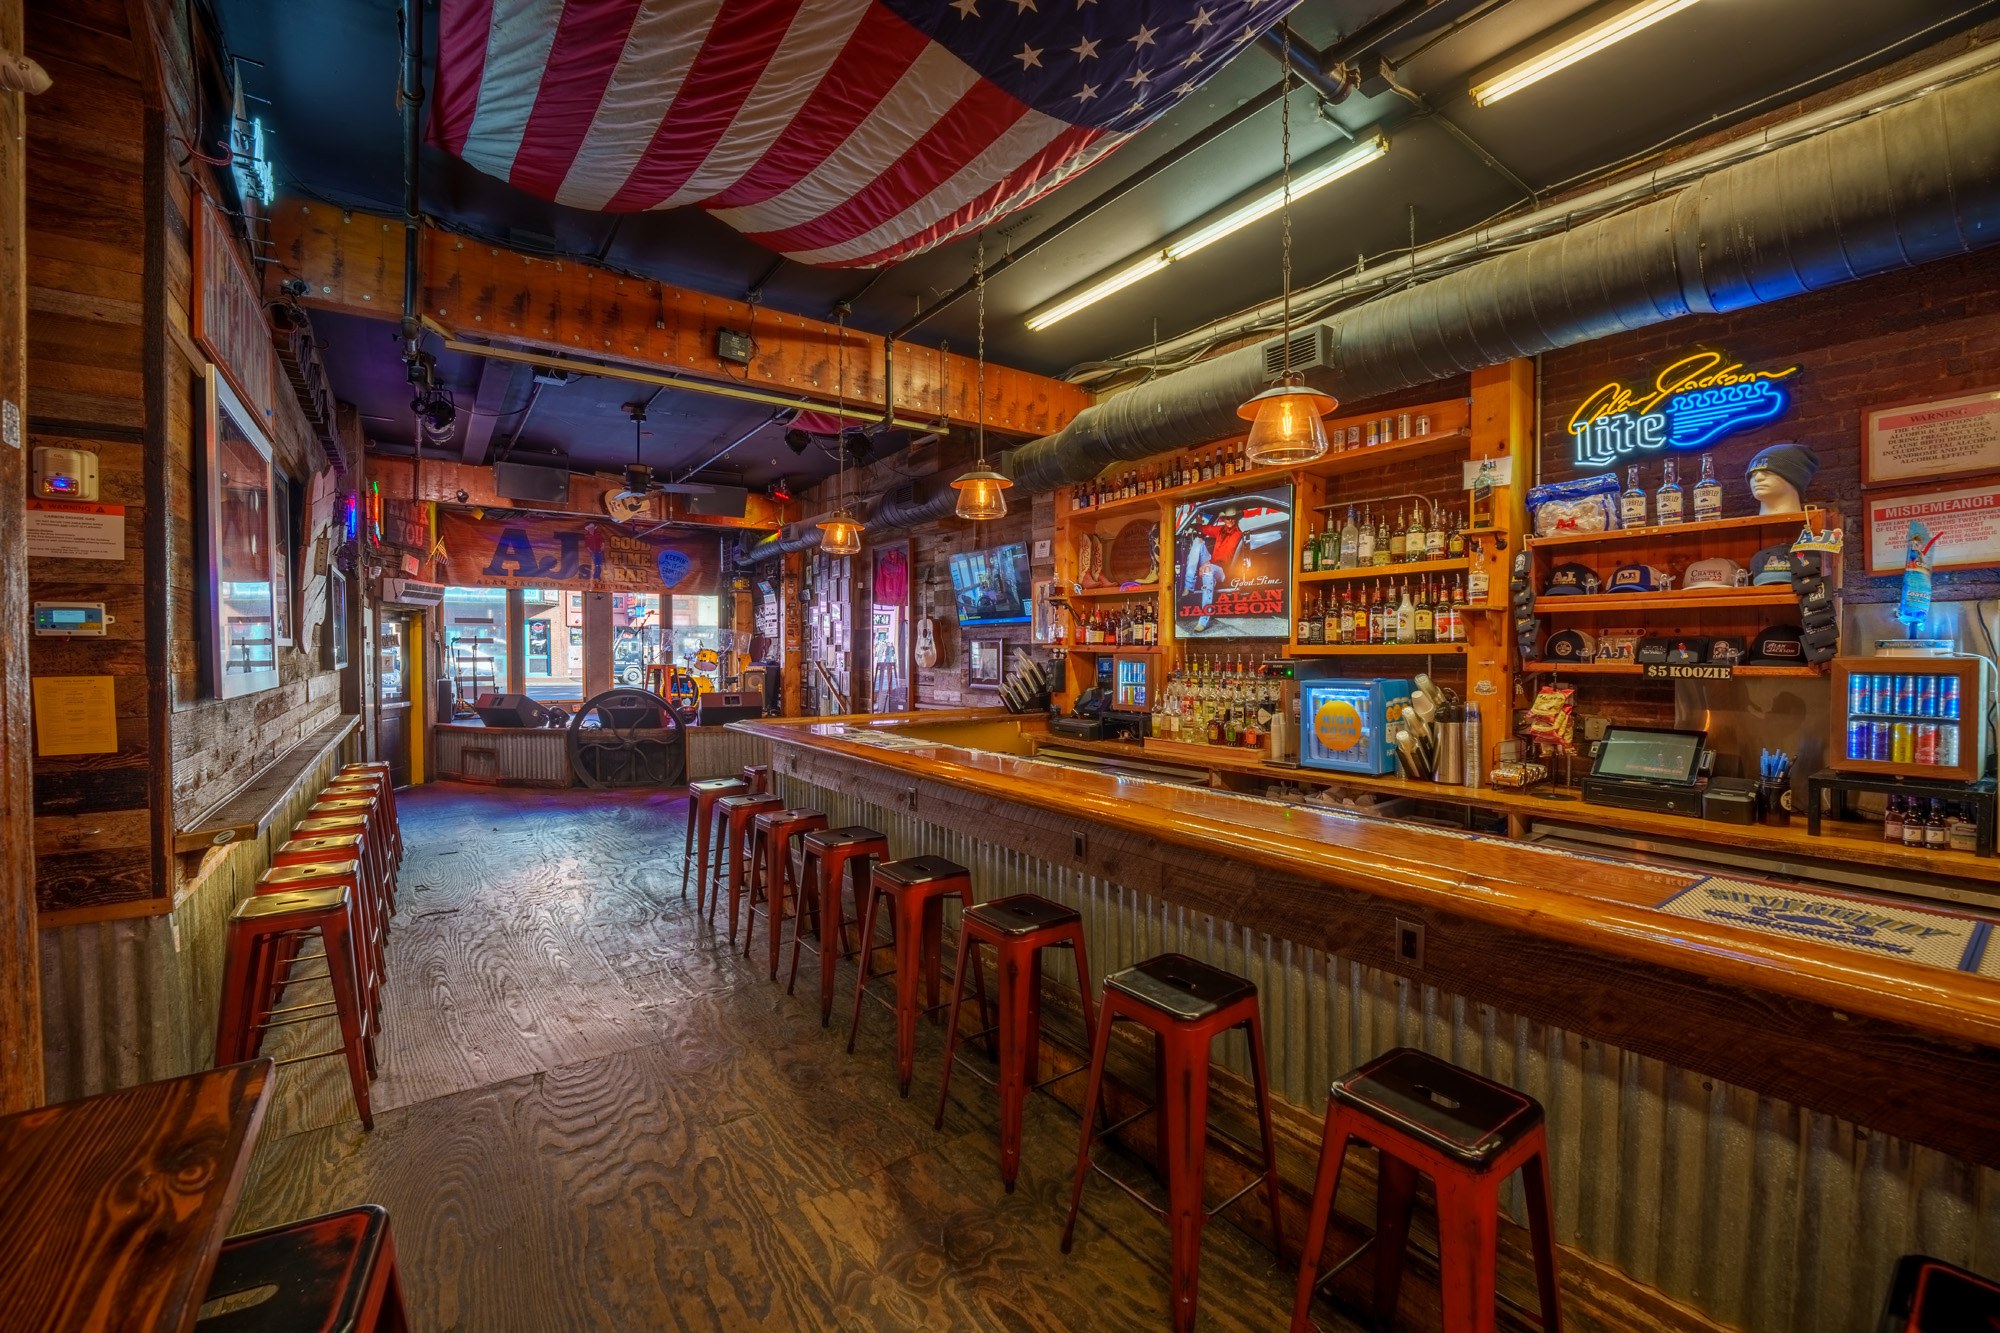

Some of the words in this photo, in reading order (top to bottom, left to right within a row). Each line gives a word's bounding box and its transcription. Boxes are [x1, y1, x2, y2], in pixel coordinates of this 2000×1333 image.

[1641, 352, 1797, 415] Jackson
[1910, 408, 1968, 423] WARNING
[1889, 428, 1935, 440] ALCOHOLIC
[1940, 421, 1991, 432] BEVERAGES
[1911, 418, 1971, 431] CONSUMPTION
[1573, 413, 1667, 466] Lite
[1888, 436, 1919, 445] DURING
[1921, 429, 1971, 440] PREGNANCY
[1920, 437, 1945, 446] BIRTH
[1882, 446, 1926, 456] INCLUDING
[1928, 442, 1953, 450] FETAL
[1957, 436, 1997, 446] ALCOHOL
[1893, 450, 1938, 460] SYNDROME
[1960, 443, 1986, 451] FETAL
[1900, 455, 1941, 464] ALCOHOL
[1942, 450, 1978, 459] EFFECTS
[48, 503, 91, 512] WARNING
[1885, 495, 1994, 518] MISDEMEANOR
[1947, 511, 1977, 520] MAXIMUM
[397, 519, 424, 546] YOU
[1885, 524, 1910, 532] ELEVEN
[1926, 519, 1956, 527] MONTHS
[1930, 521, 1984, 532] IMPRISONMENT
[611, 535, 652, 551] GOOD
[610, 551, 652, 567] TIME
[613, 567, 648, 583] BAR
[1230, 578, 1256, 589] Good
[1257, 575, 1282, 586] Time
[1217, 588, 1284, 604] ALAN
[1180, 600, 1284, 617] JACKSON
[1144, 626, 1151, 641] 7
[1647, 664, 1668, 678] $5
[1669, 666, 1731, 679] KOOZIE
[1321, 714, 1354, 725] HIGH
[1320, 725, 1356, 736] NOON
